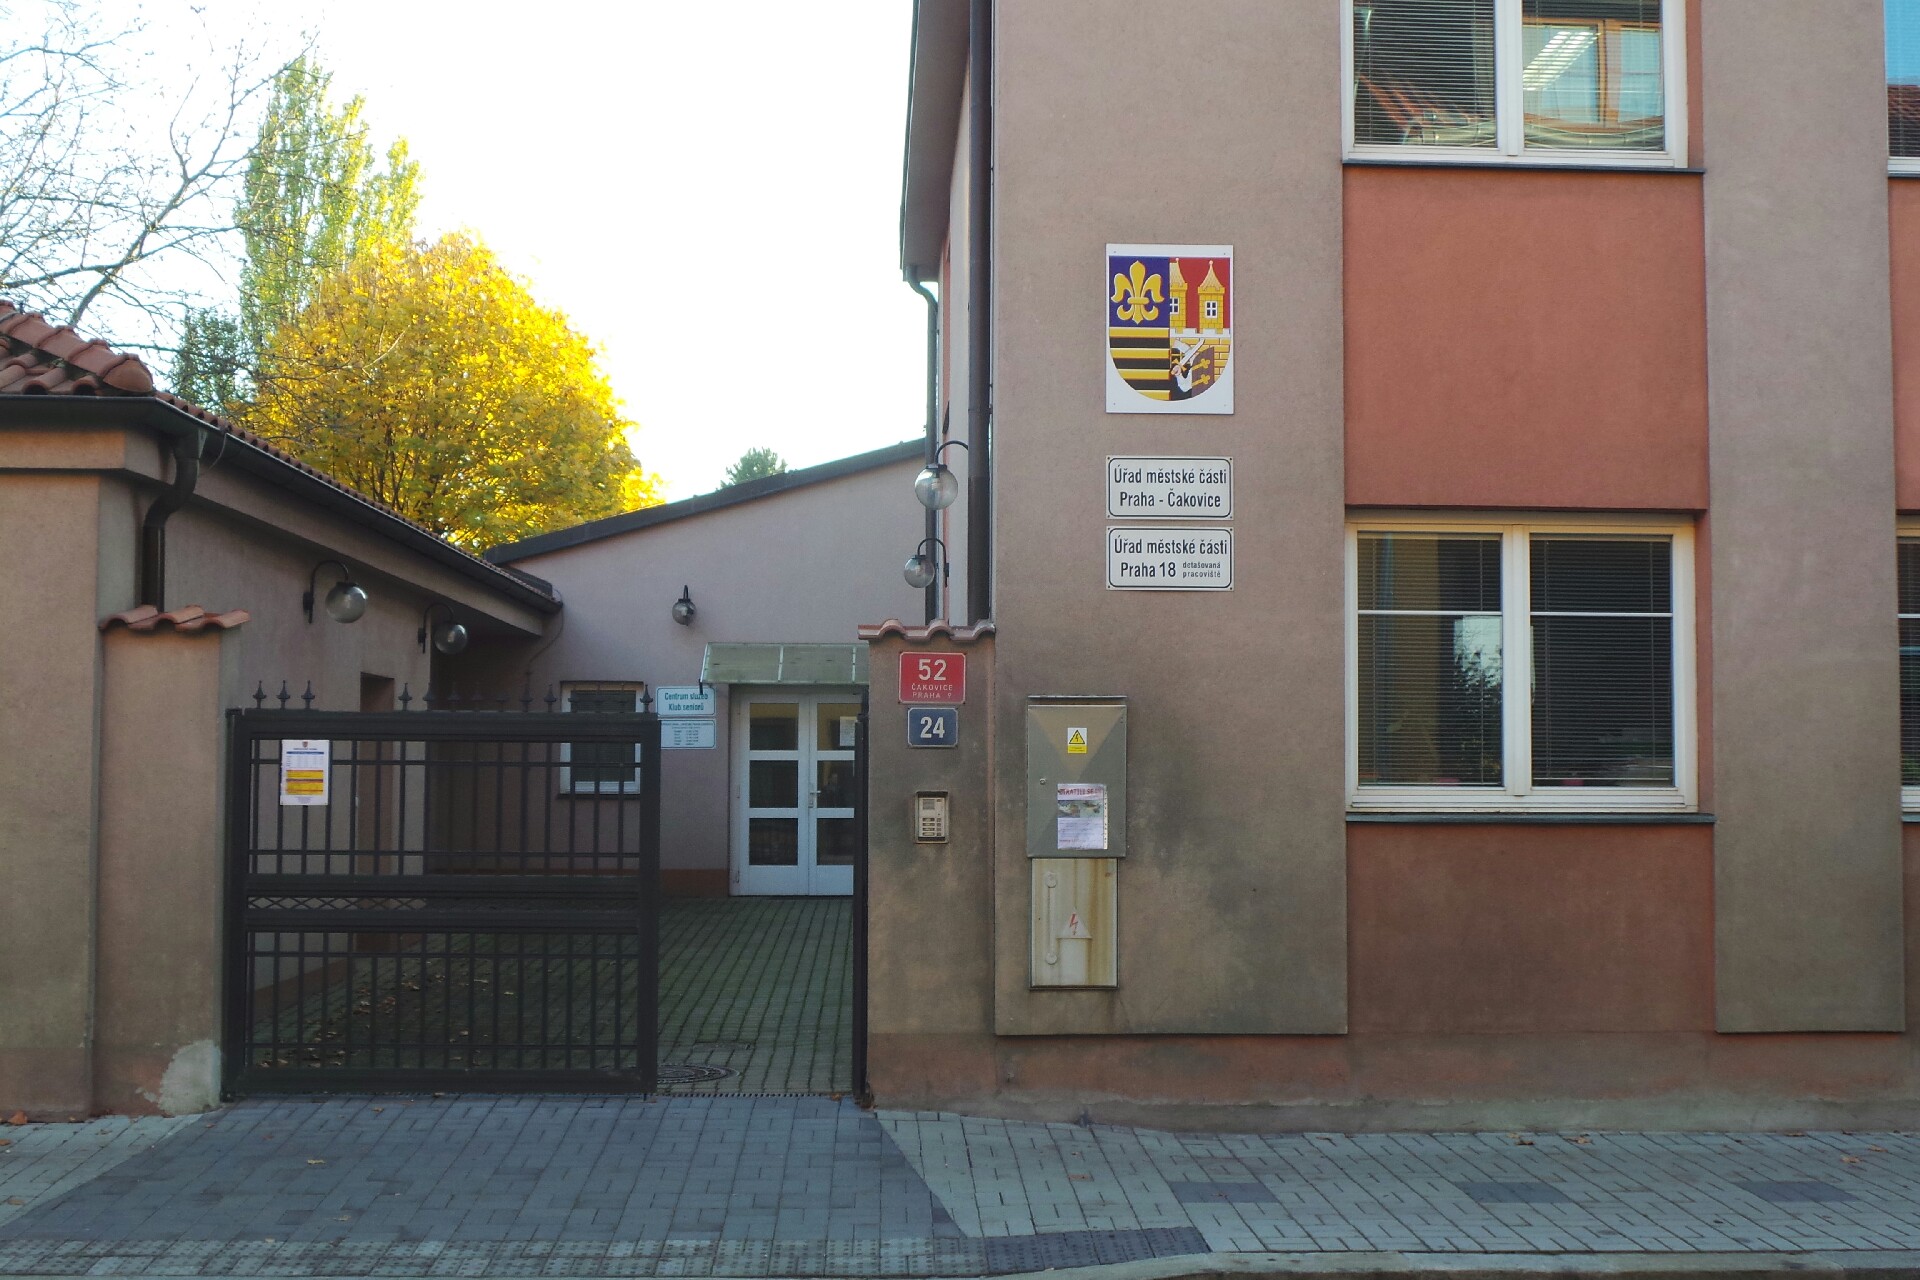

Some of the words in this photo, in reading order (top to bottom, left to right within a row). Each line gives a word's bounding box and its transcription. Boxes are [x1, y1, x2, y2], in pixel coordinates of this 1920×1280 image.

[1114, 464, 1142, 484] Úřad
[1146, 468, 1195, 484] městské
[1199, 468, 1227, 484] části
[1120, 491, 1155, 507] Praha
[1167, 488, 1221, 507] Čakovice
[1114, 535, 1142, 554] Úřad
[1147, 538, 1196, 555] městské
[1199, 538, 1227, 555] části
[1120, 562, 1156, 578] Praha
[1159, 561, 1176, 578] 18
[1182, 561, 1221, 569] detašovaná
[1182, 570, 1221, 579] pracoviště
[918, 659, 947, 681] 52
[911, 683, 953, 691] ČAKOVICE
[664, 692, 689, 700] Centrum
[668, 703, 682, 711] Klub
[682, 702, 705, 711] seniorů
[920, 716, 945, 739] 24
